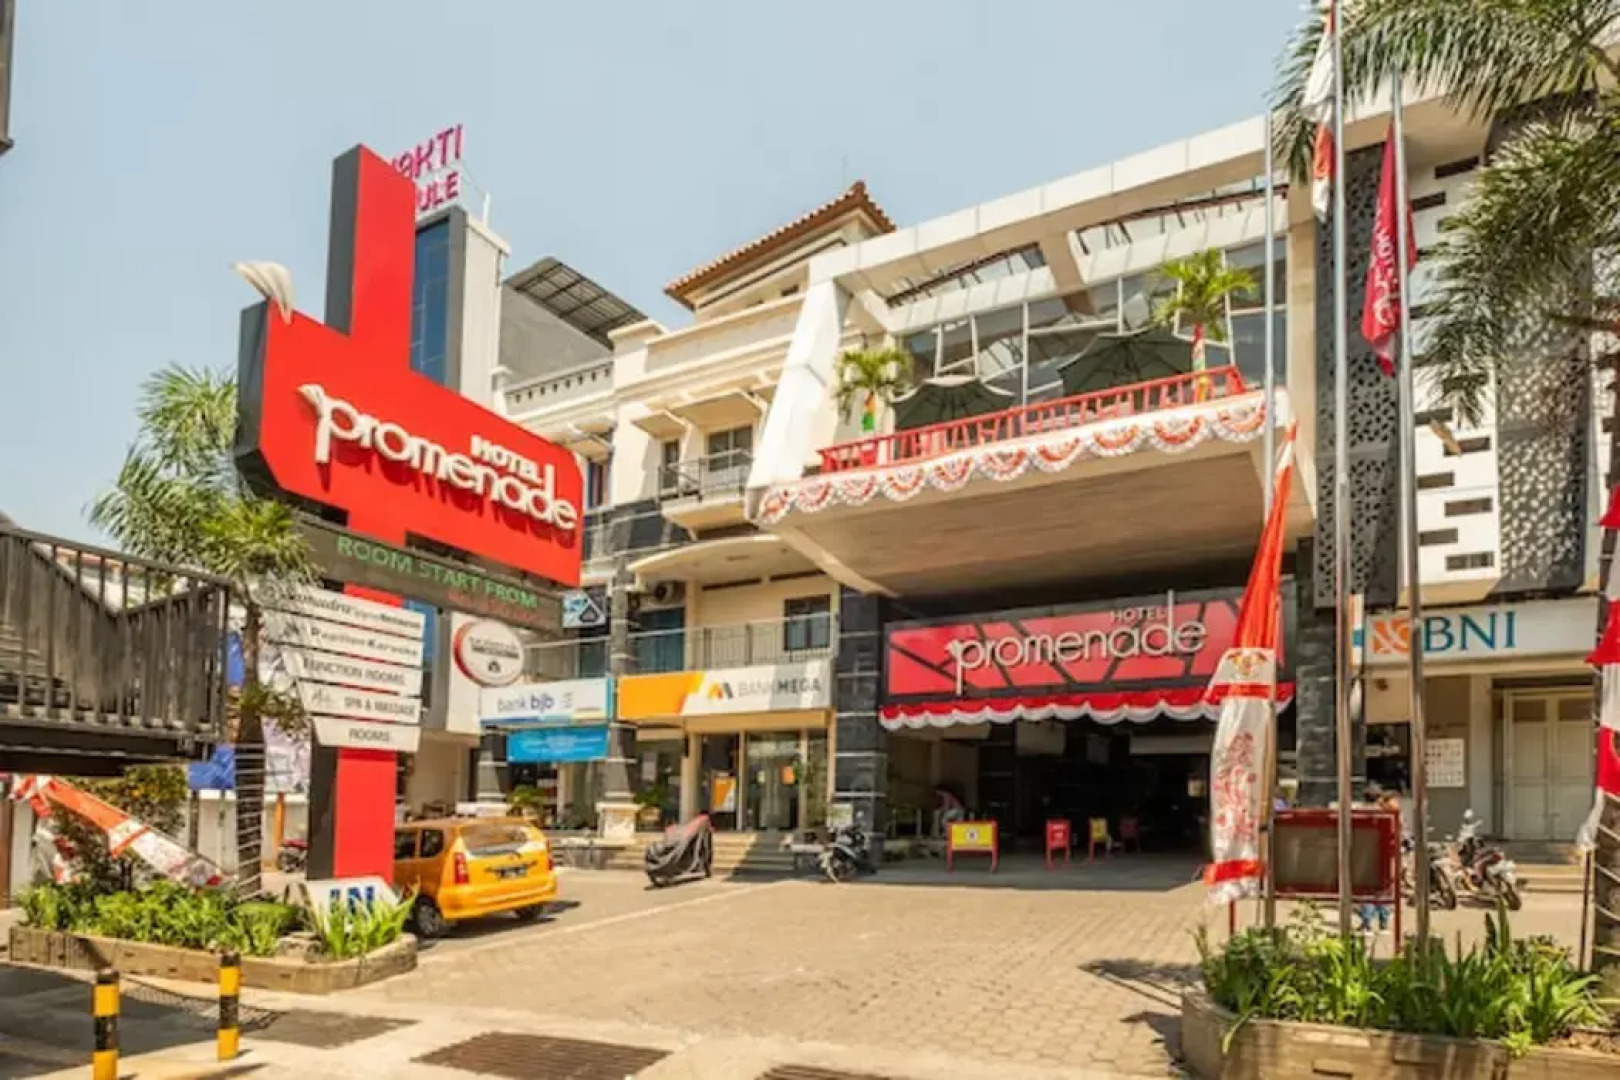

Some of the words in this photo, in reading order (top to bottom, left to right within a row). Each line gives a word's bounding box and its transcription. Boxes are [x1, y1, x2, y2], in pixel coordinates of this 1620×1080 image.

[298, 384, 577, 530] promenade
[470, 434, 544, 484] HOTEL
[337, 536, 412, 573] ROOM
[419, 561, 480, 590] START
[485, 581, 539, 609] FROM
[944, 589, 1207, 697] promenade
[1110, 606, 1168, 624] HOTEL
[1423, 611, 1516, 652] BNI
